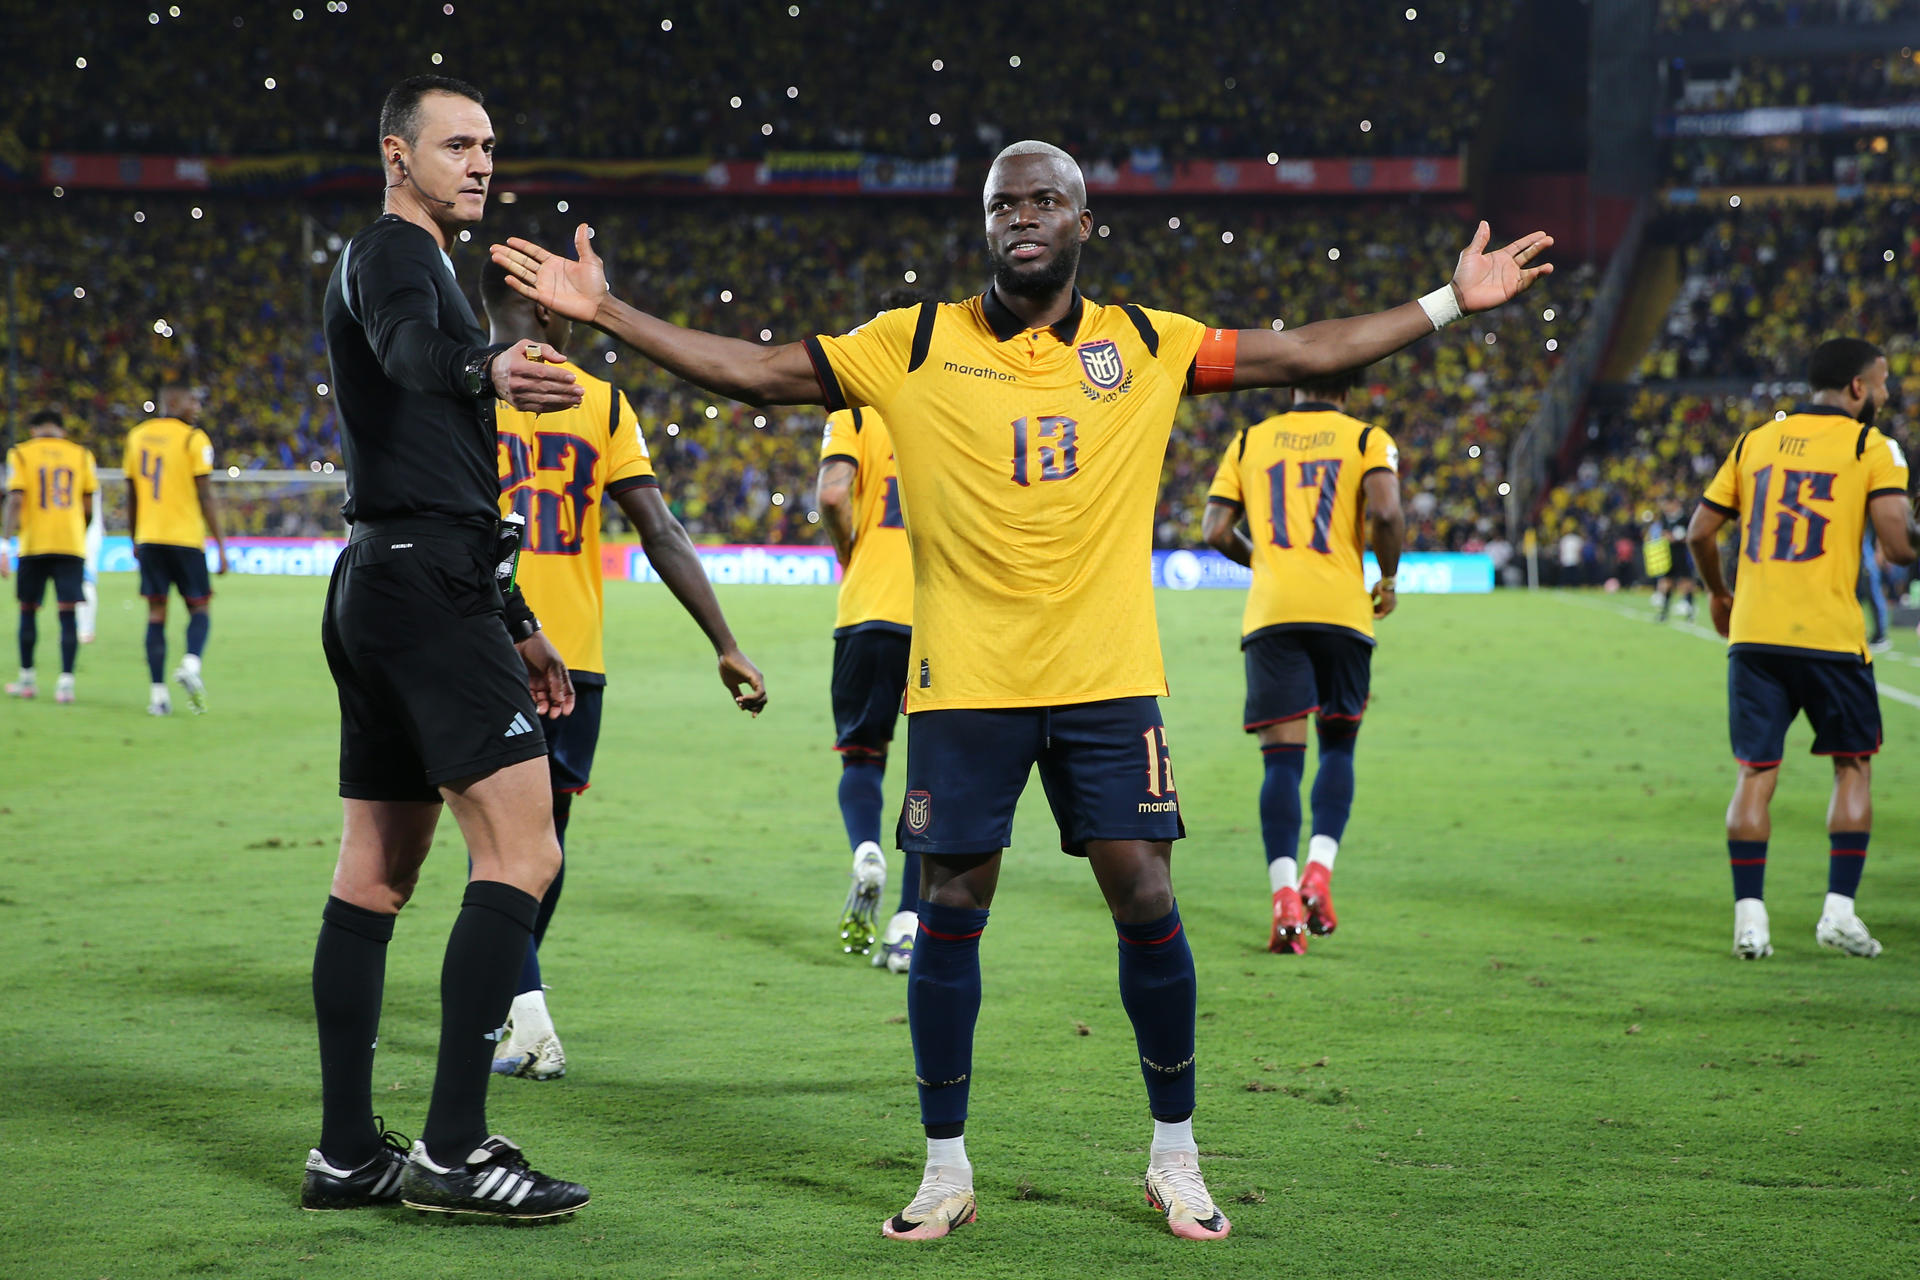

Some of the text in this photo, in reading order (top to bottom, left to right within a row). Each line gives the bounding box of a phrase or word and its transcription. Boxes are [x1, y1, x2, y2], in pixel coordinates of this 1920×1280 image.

[943, 361, 1017, 382] marathon
[1103, 392, 1118, 403] 100
[1011, 416, 1079, 487] 13
[1779, 435, 1808, 457] VITE
[140, 448, 163, 500] 4
[1266, 459, 1343, 554] 17
[1745, 464, 1838, 563] 15
